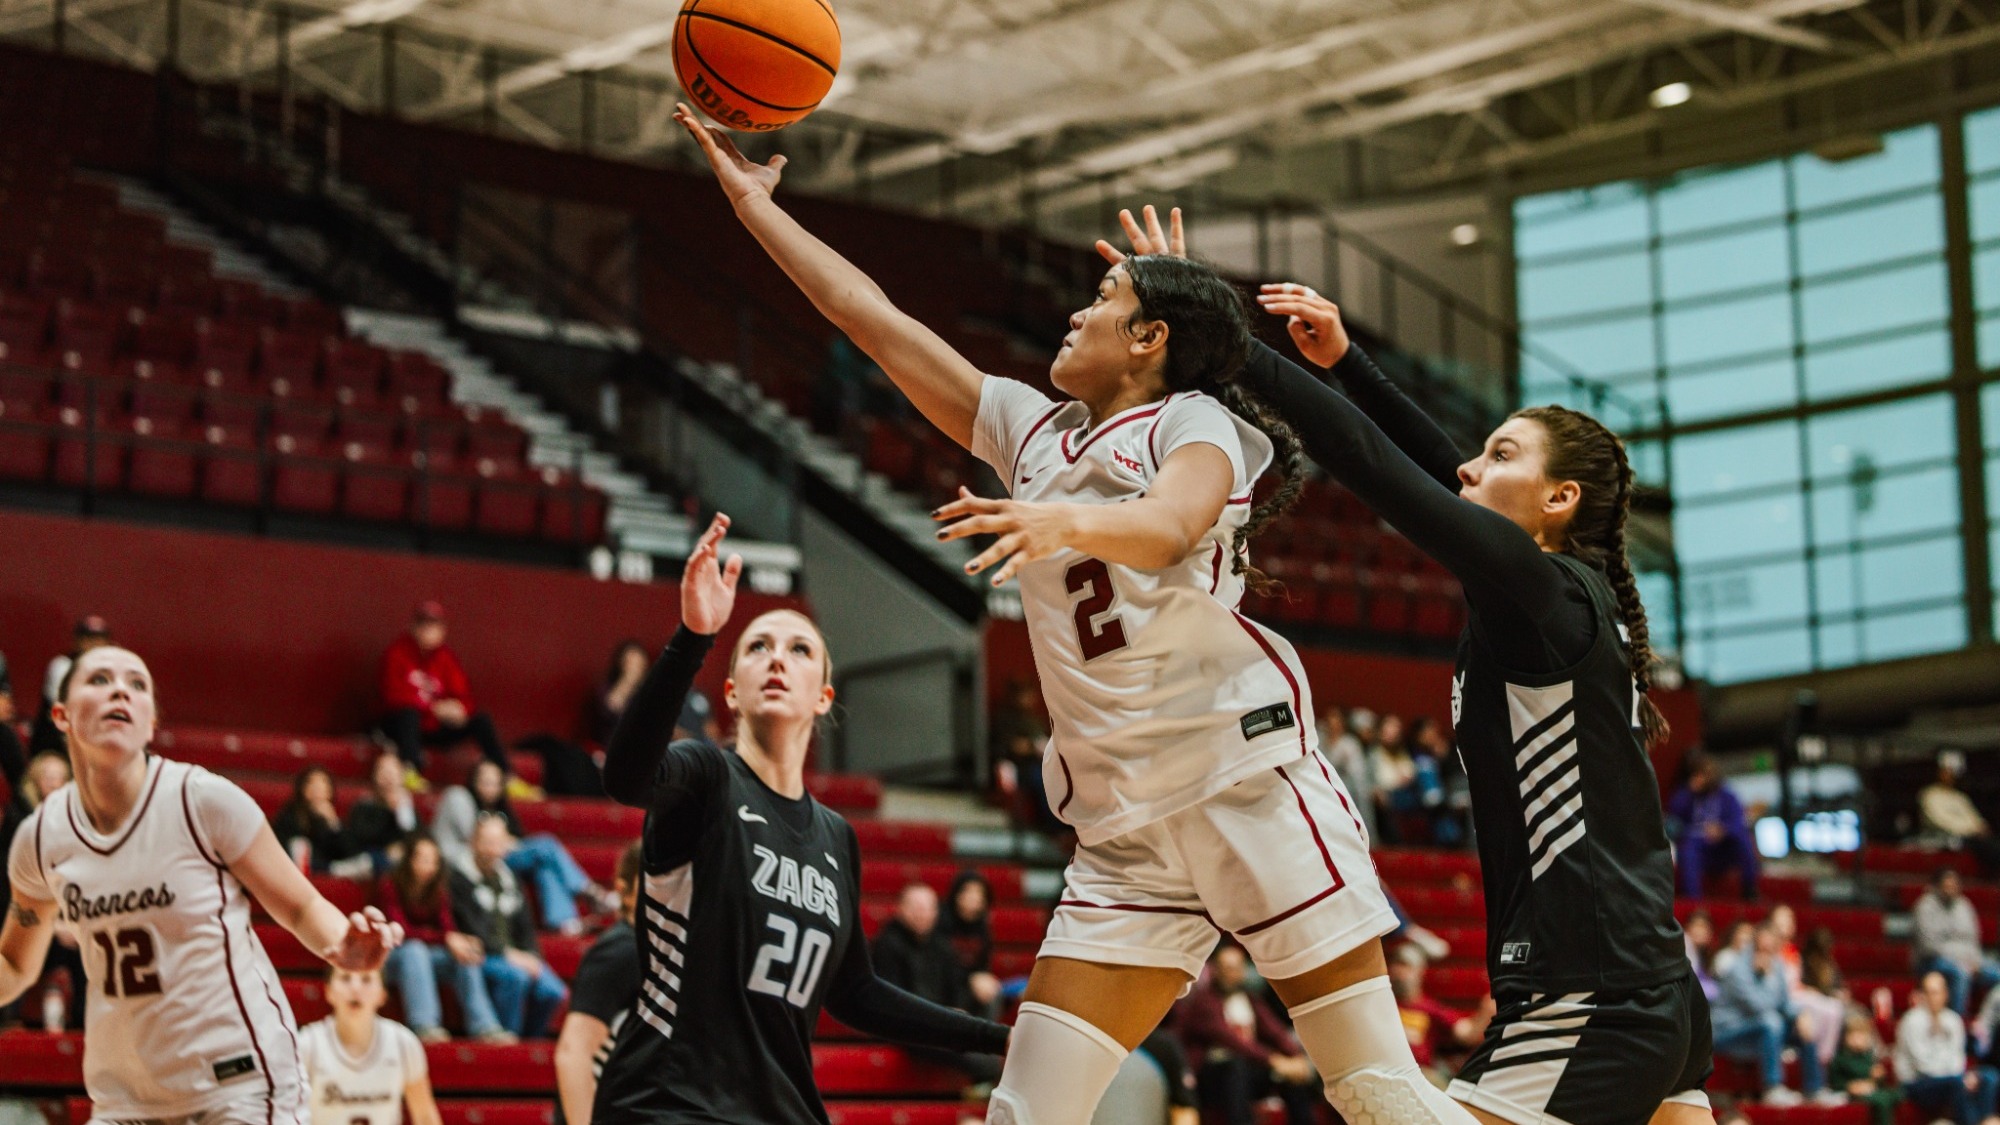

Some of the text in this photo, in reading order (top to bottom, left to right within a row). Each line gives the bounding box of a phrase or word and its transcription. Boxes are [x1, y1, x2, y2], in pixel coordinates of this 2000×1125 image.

[691, 72, 794, 131] Wilson
[1063, 556, 1130, 664] 2
[1277, 710, 1287, 722] M
[59, 882, 176, 922] Broncos
[751, 843, 841, 928] ZAGS
[93, 926, 164, 998] 12
[747, 912, 832, 1009] 20
